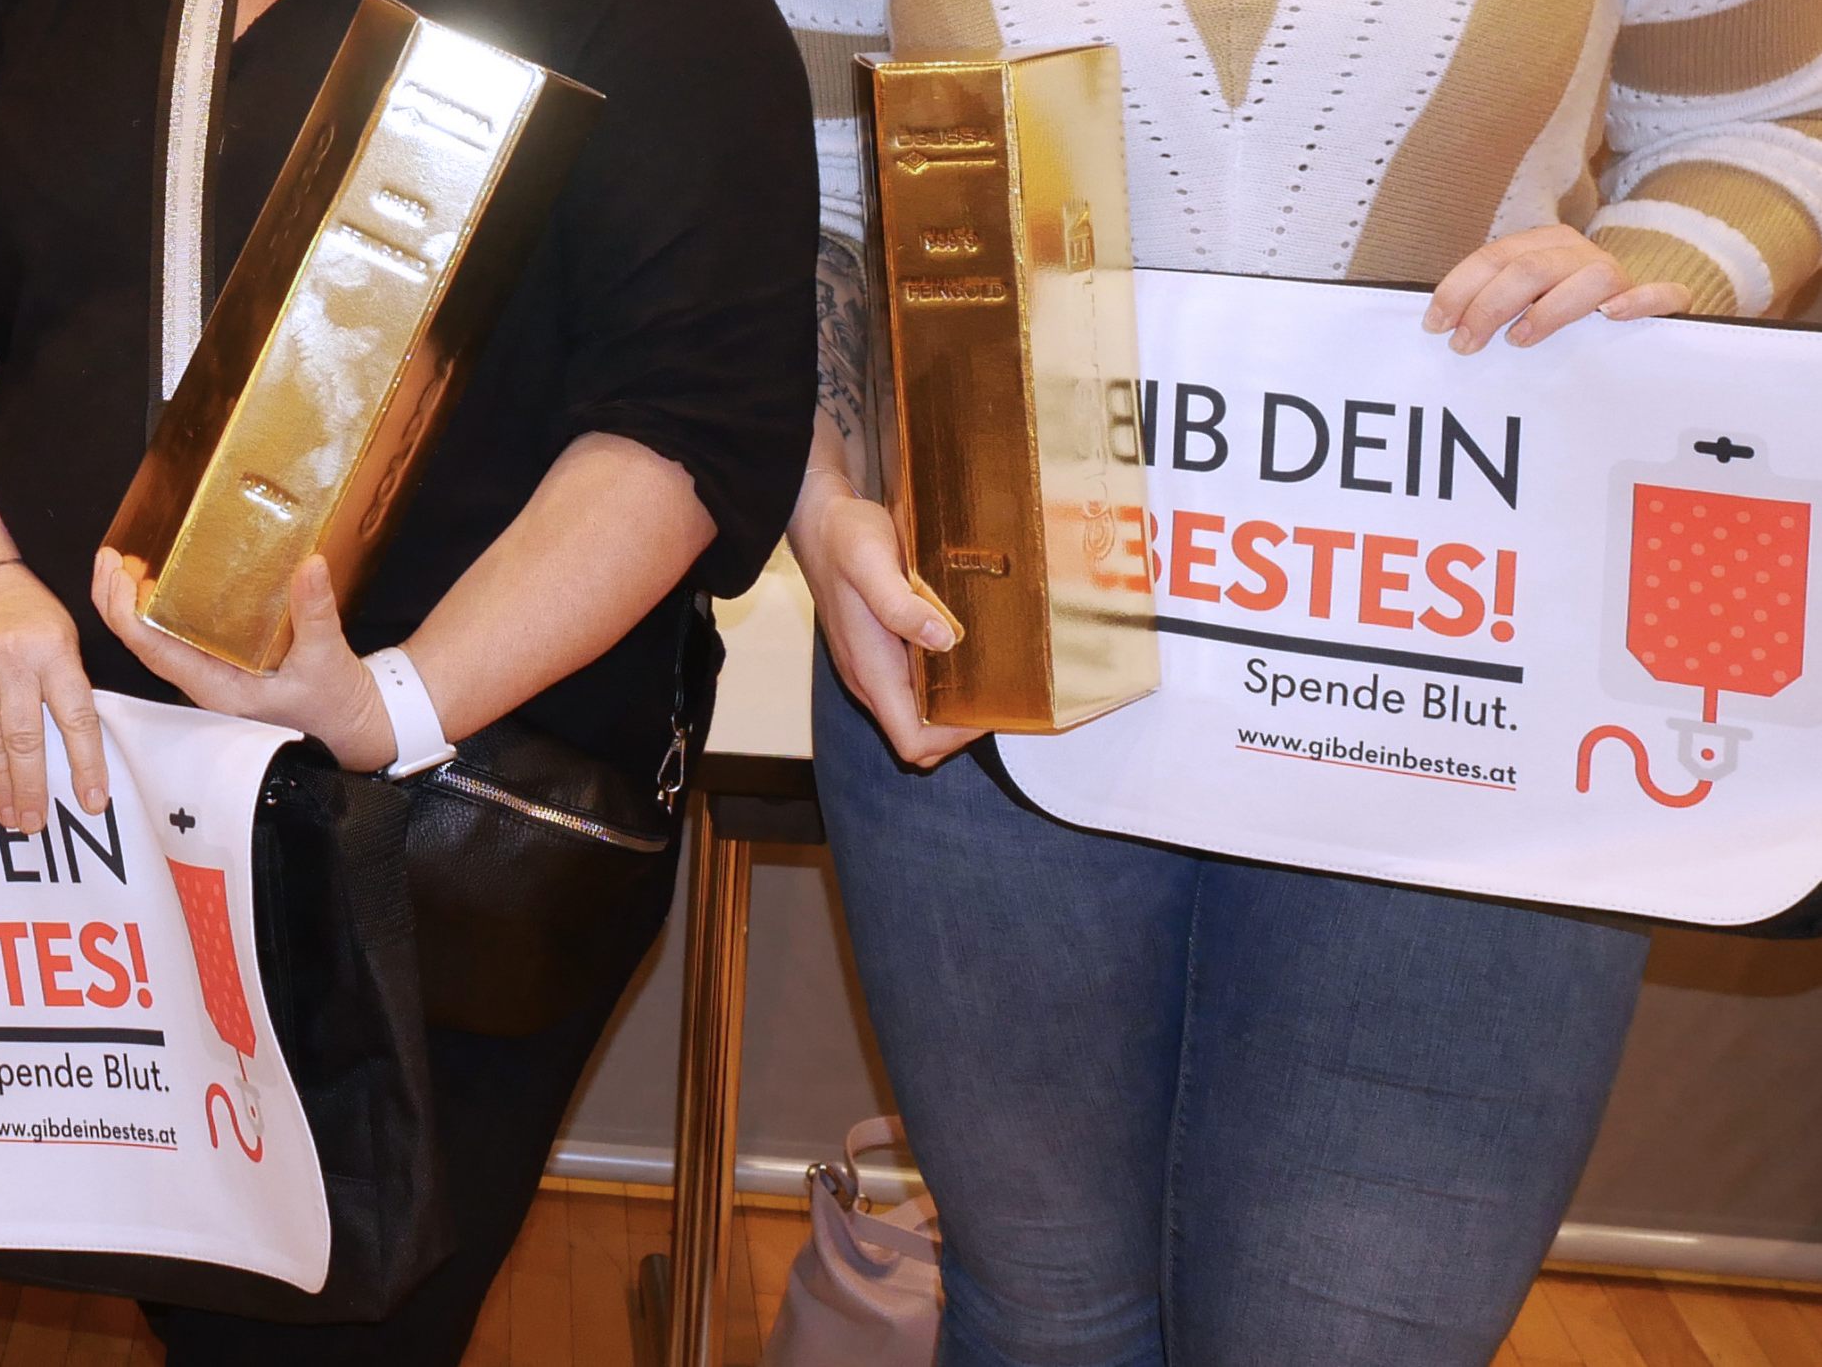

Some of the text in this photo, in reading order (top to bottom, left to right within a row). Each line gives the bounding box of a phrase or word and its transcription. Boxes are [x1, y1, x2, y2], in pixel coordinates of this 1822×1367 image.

[1138, 379, 1521, 510] IB DEIN
[1244, 658, 1518, 731] Spende Blut.
[1237, 728, 1518, 786] www.gibdeinbestes.at
[104, 1053, 170, 1093] Blut.
